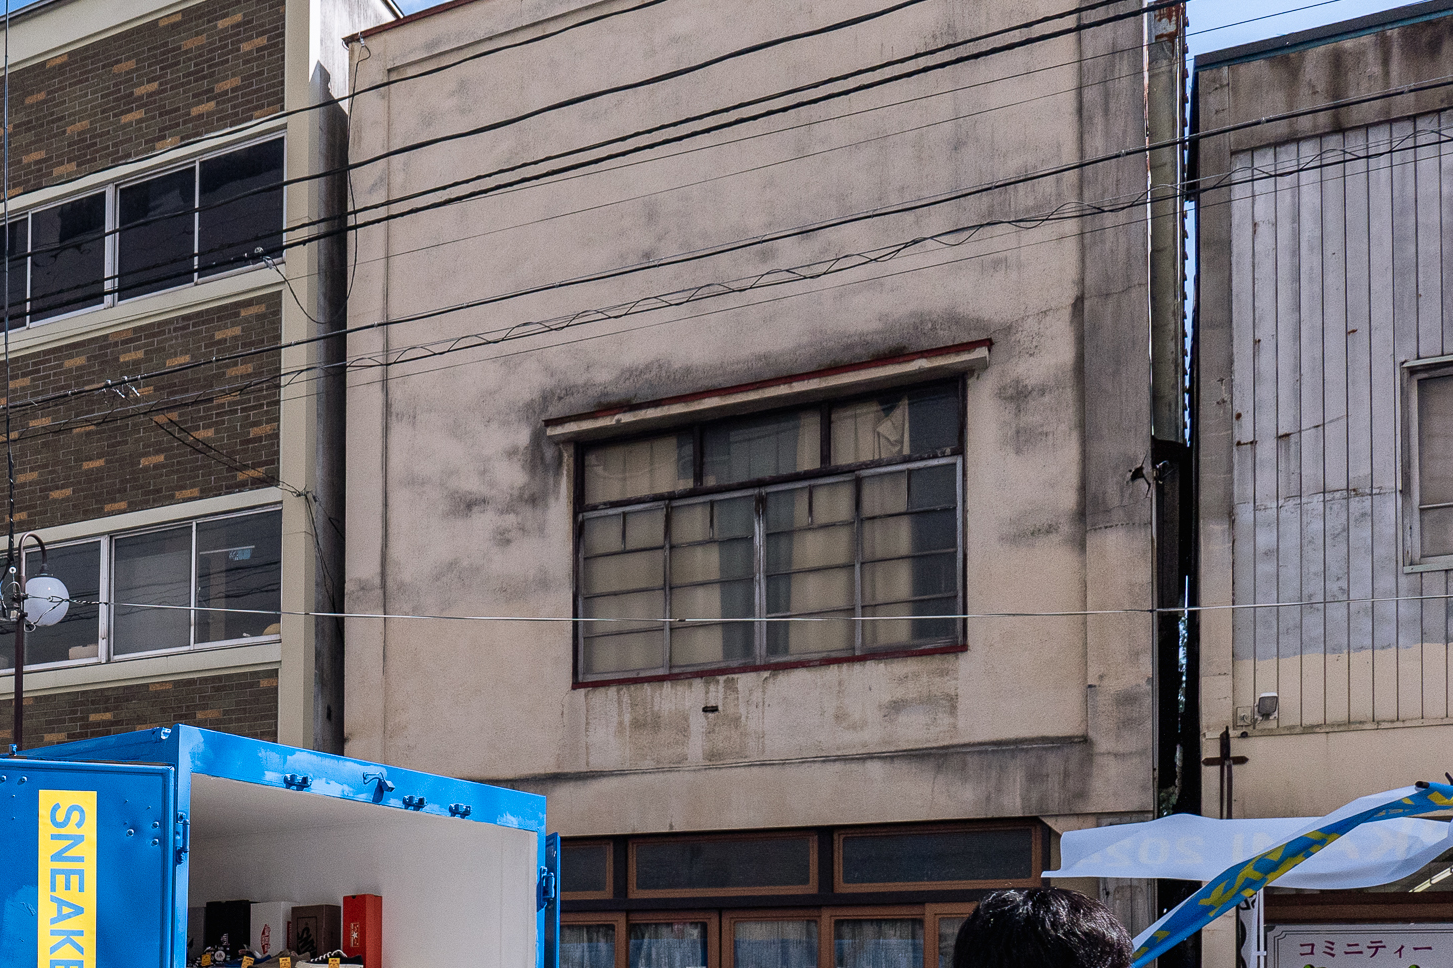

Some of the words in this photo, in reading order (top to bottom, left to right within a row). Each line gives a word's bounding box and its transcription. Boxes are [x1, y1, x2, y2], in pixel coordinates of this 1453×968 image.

[1299, 939, 1433, 958] コミニティー
